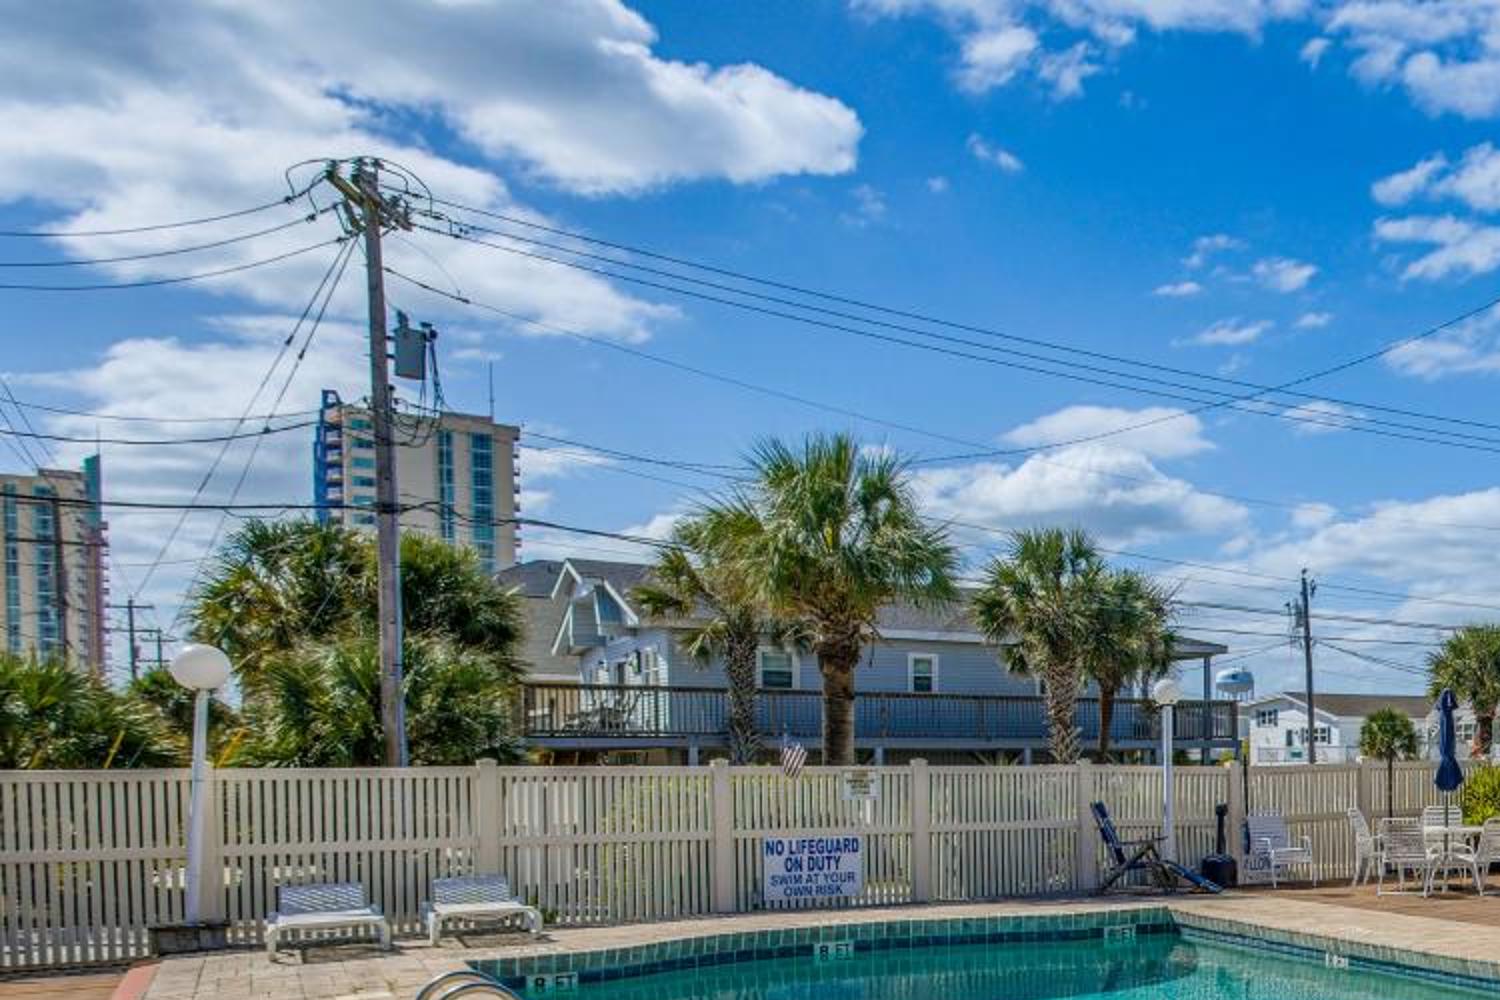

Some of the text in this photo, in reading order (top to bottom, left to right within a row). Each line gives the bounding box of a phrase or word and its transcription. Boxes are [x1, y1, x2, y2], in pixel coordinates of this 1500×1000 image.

[766, 838, 860, 856] NO LIFEGUARD
[785, 856, 841, 872] ON DUTY
[770, 872, 857, 887] SWIM AT YOUR
[784, 885, 844, 898] OWN RISK
